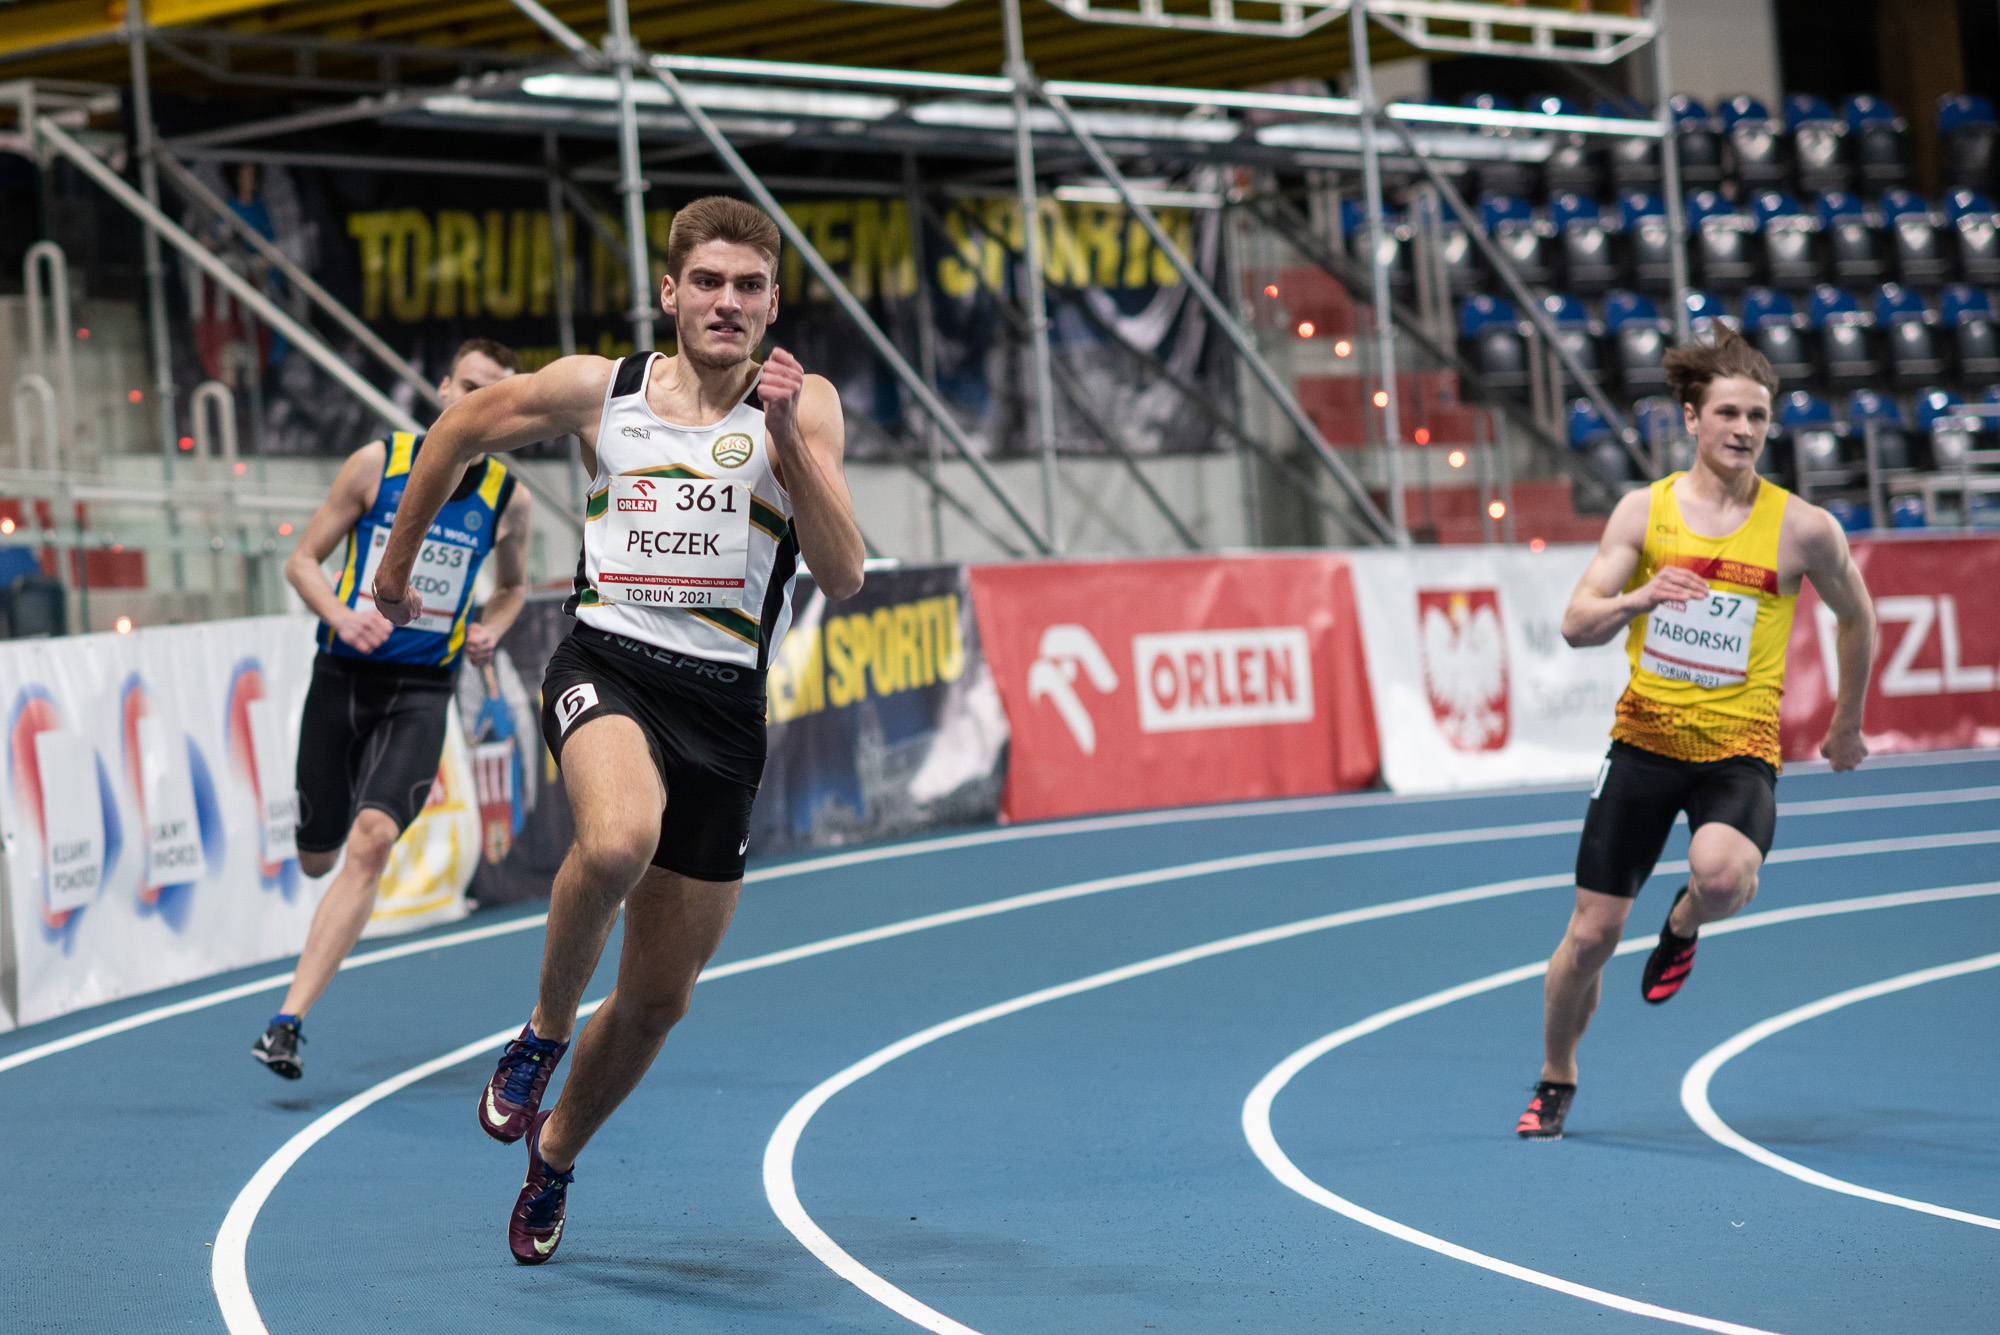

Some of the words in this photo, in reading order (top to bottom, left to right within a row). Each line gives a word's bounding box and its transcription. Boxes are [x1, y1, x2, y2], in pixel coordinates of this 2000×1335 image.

[718, 438, 748, 452] RKS
[618, 500, 655, 512] ORLEN
[675, 483, 737, 513] 361
[444, 527, 478, 547] WOLA
[626, 530, 720, 558] PĘCZEK
[421, 544, 464, 568] 653
[620, 575, 644, 583] HALOWE
[645, 577, 690, 585] MISTRZOSTWA
[625, 587, 674, 603] TORUŃ
[678, 590, 712, 604] 2021
[1709, 596, 1742, 619] 57
[1653, 616, 1742, 654] TABORSKI
[826, 594, 965, 708] SPORTU
[675, 653, 740, 683] PRO
[1151, 647, 1296, 711] ORLEN
[1694, 672, 1720, 686] 2021
[562, 687, 586, 723] 5
